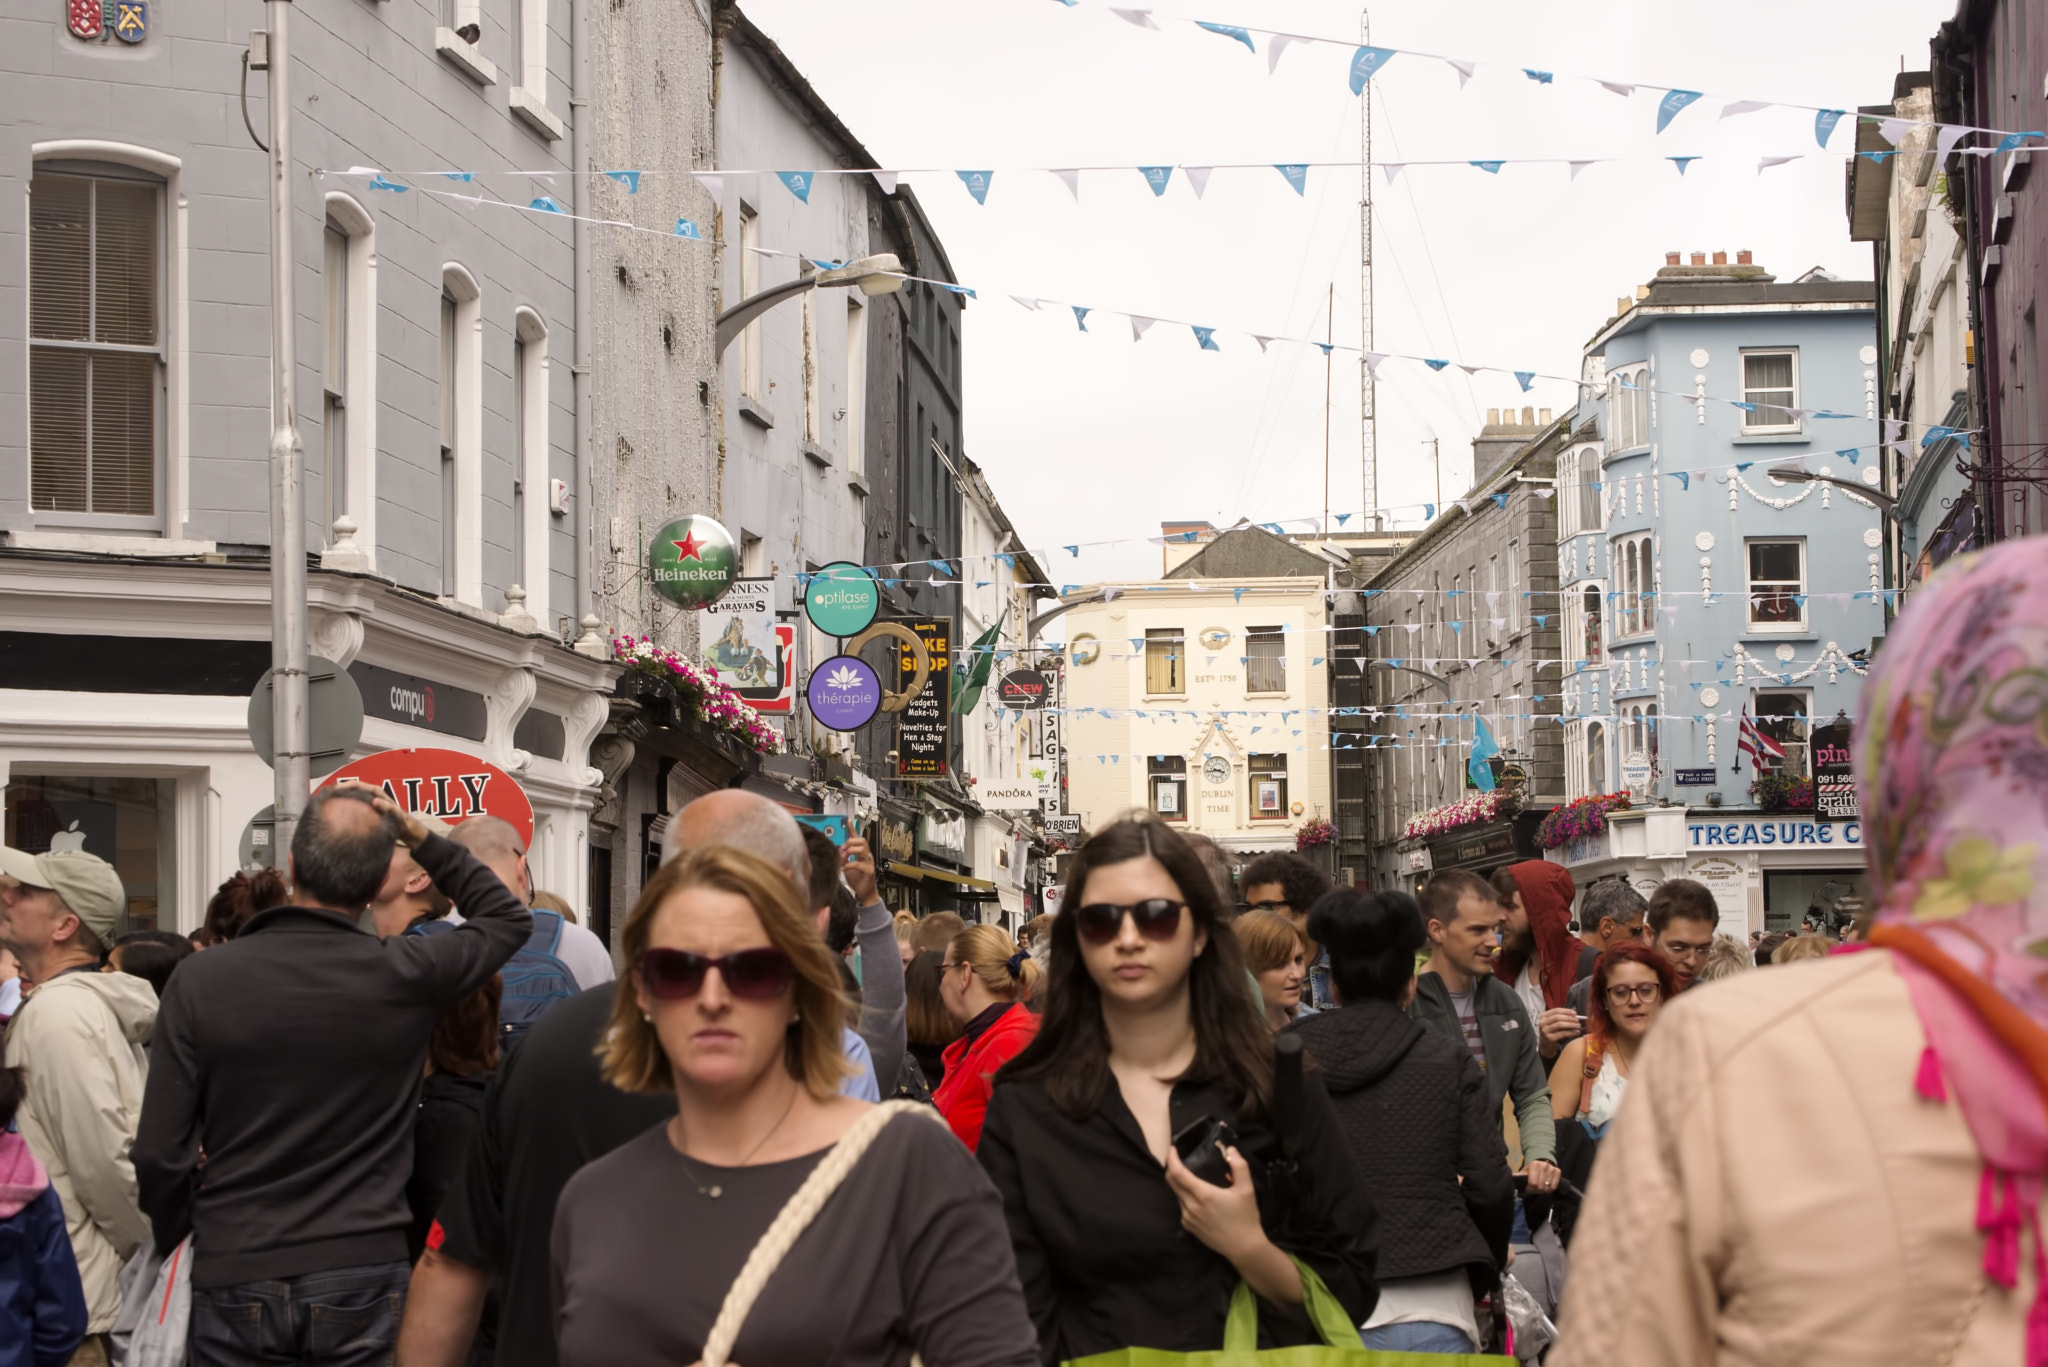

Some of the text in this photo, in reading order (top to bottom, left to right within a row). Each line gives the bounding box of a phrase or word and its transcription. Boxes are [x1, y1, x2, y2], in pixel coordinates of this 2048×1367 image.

[654, 567, 728, 582] Heineken
[707, 600, 766, 614] GARAVANS
[902, 638, 946, 652] JKE
[902, 657, 947, 671] SOP
[1004, 683, 1043, 695] CREW
[817, 690, 872, 706] thérapie
[908, 708, 939, 718] Make-Up
[900, 723, 947, 732] Novelties for
[904, 733, 918, 741] Hen
[927, 733, 942, 743] Stag
[911, 743, 935, 753] Nights
[1818, 775, 1855, 783] 091 566
[336, 773, 491, 819] ALLY
[1201, 790, 1234, 798] DUBLIN
[1207, 805, 1230, 813] TIME
[1045, 819, 1078, 830] O'BRIEN
[1688, 823, 1833, 845] TREASURE
